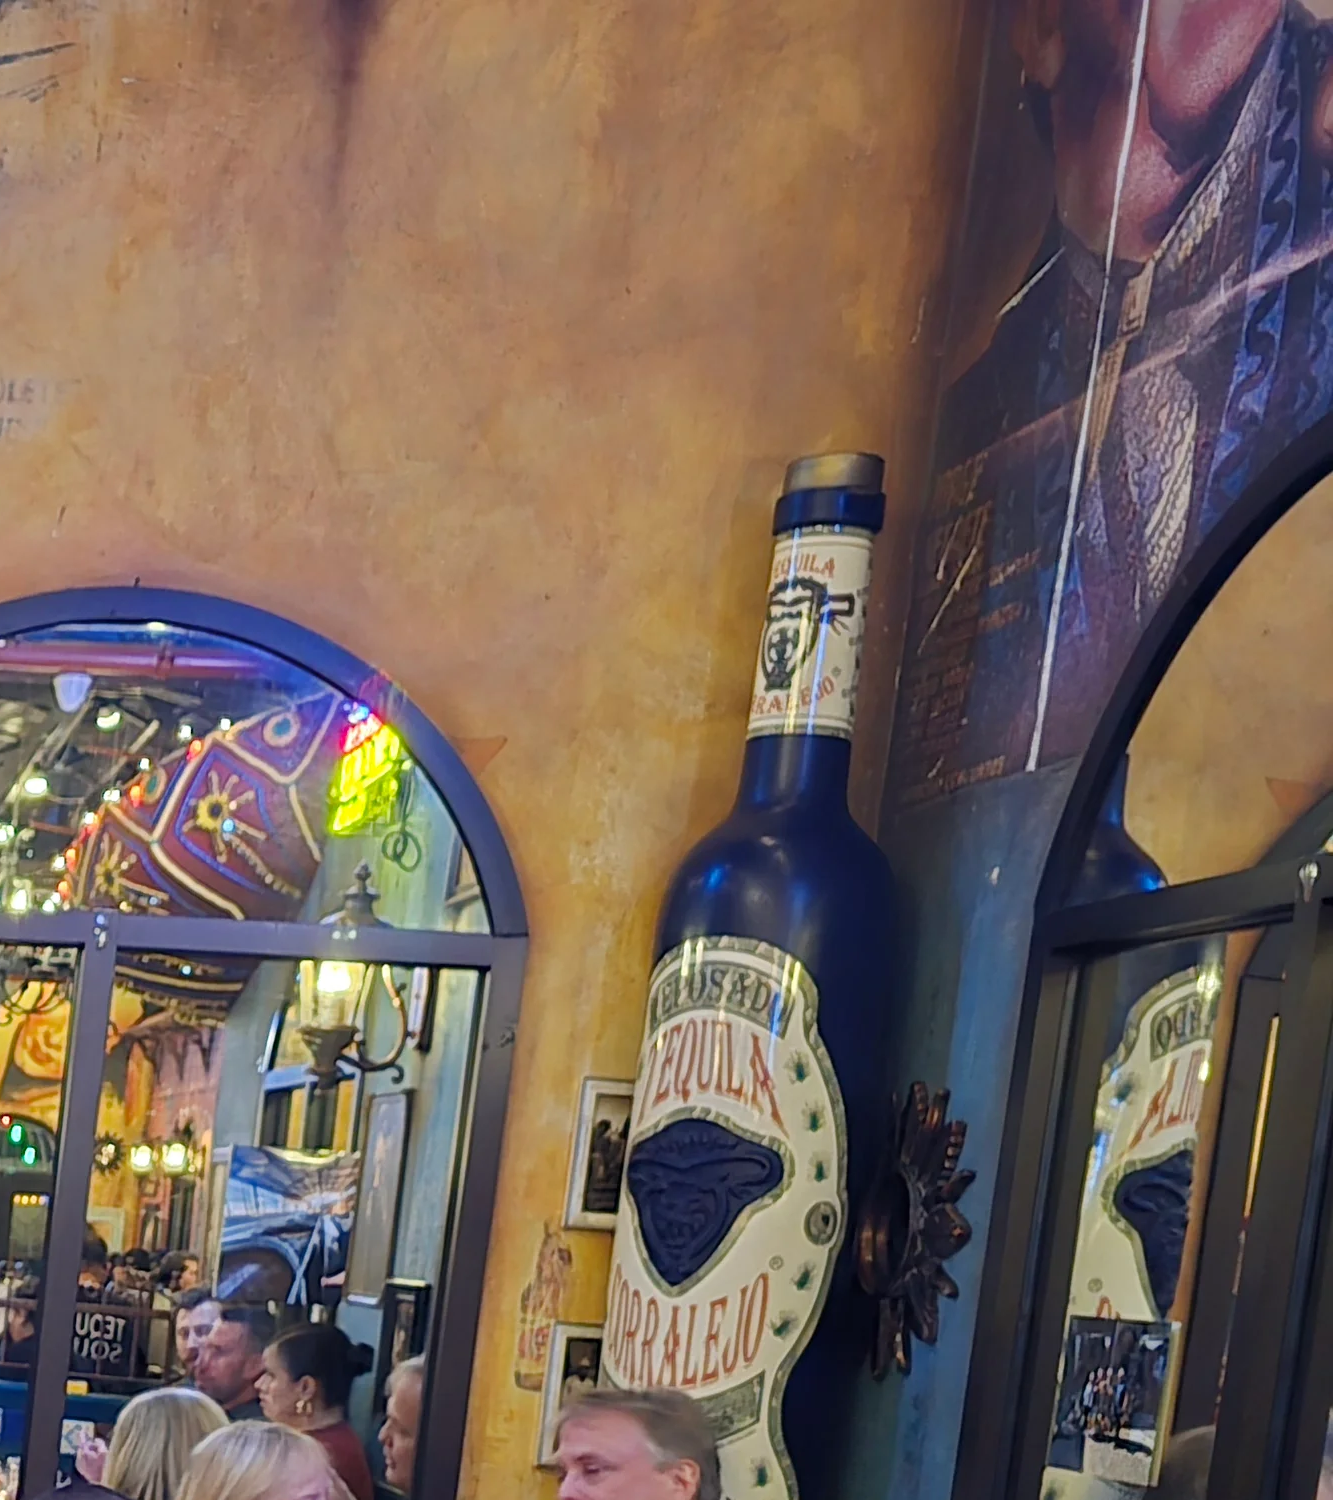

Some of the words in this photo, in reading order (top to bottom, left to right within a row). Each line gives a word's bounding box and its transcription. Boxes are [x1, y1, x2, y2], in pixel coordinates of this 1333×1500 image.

[773, 553, 836, 579] EQUILA
[636, 1017, 790, 1137] TEQUILA
[608, 1262, 769, 1388] CORRALEJO
